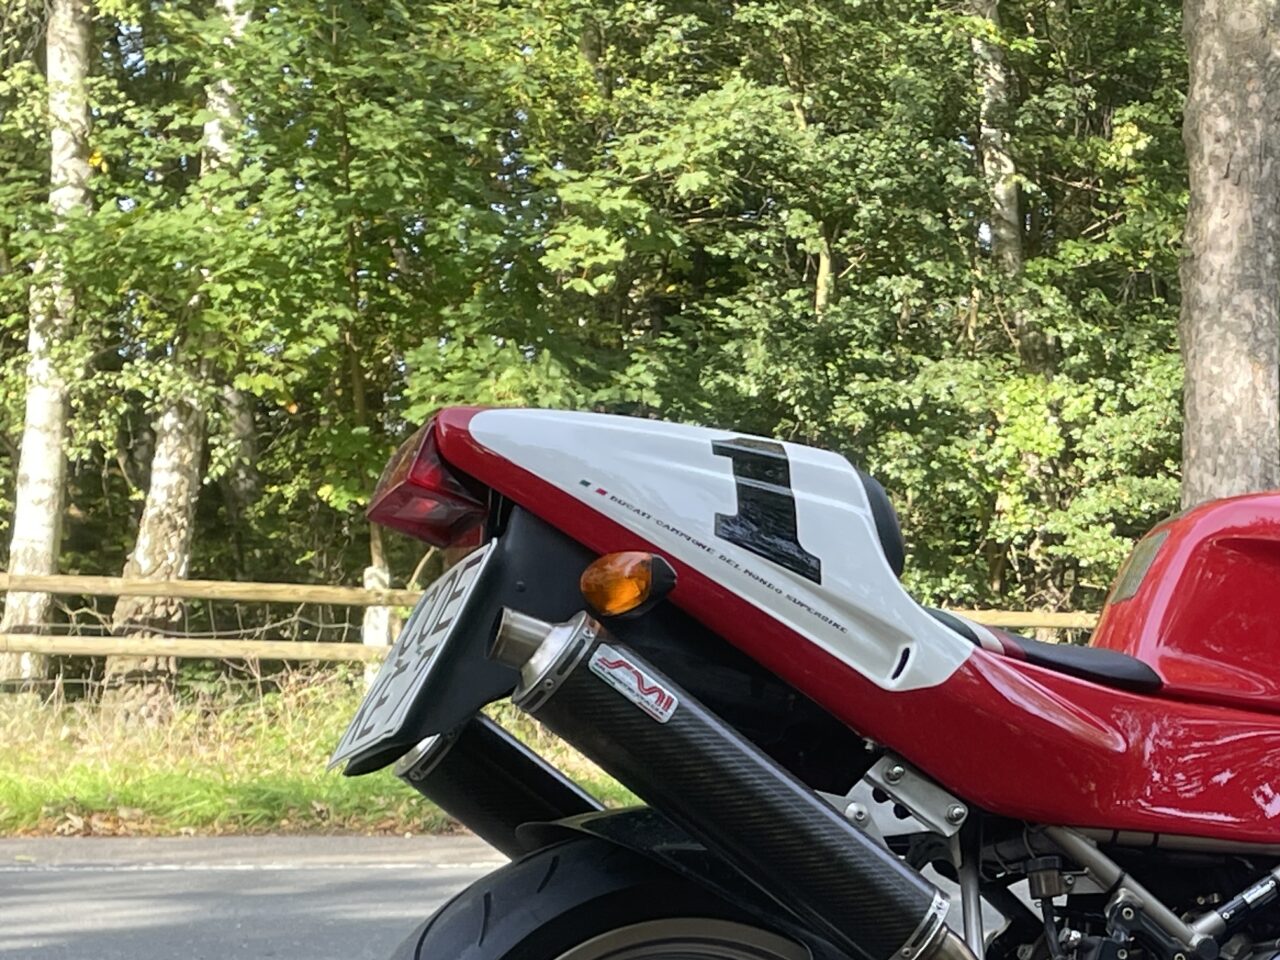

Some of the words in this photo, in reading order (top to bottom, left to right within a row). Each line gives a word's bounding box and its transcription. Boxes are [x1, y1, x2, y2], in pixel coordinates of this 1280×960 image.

[610, 495, 652, 519] DUCATI
[655, 519, 716, 555] CAMPIONE
[718, 554, 742, 571] DEL
[785, 594, 849, 634] SUPERBIKE
[711, 437, 822, 586] 1
